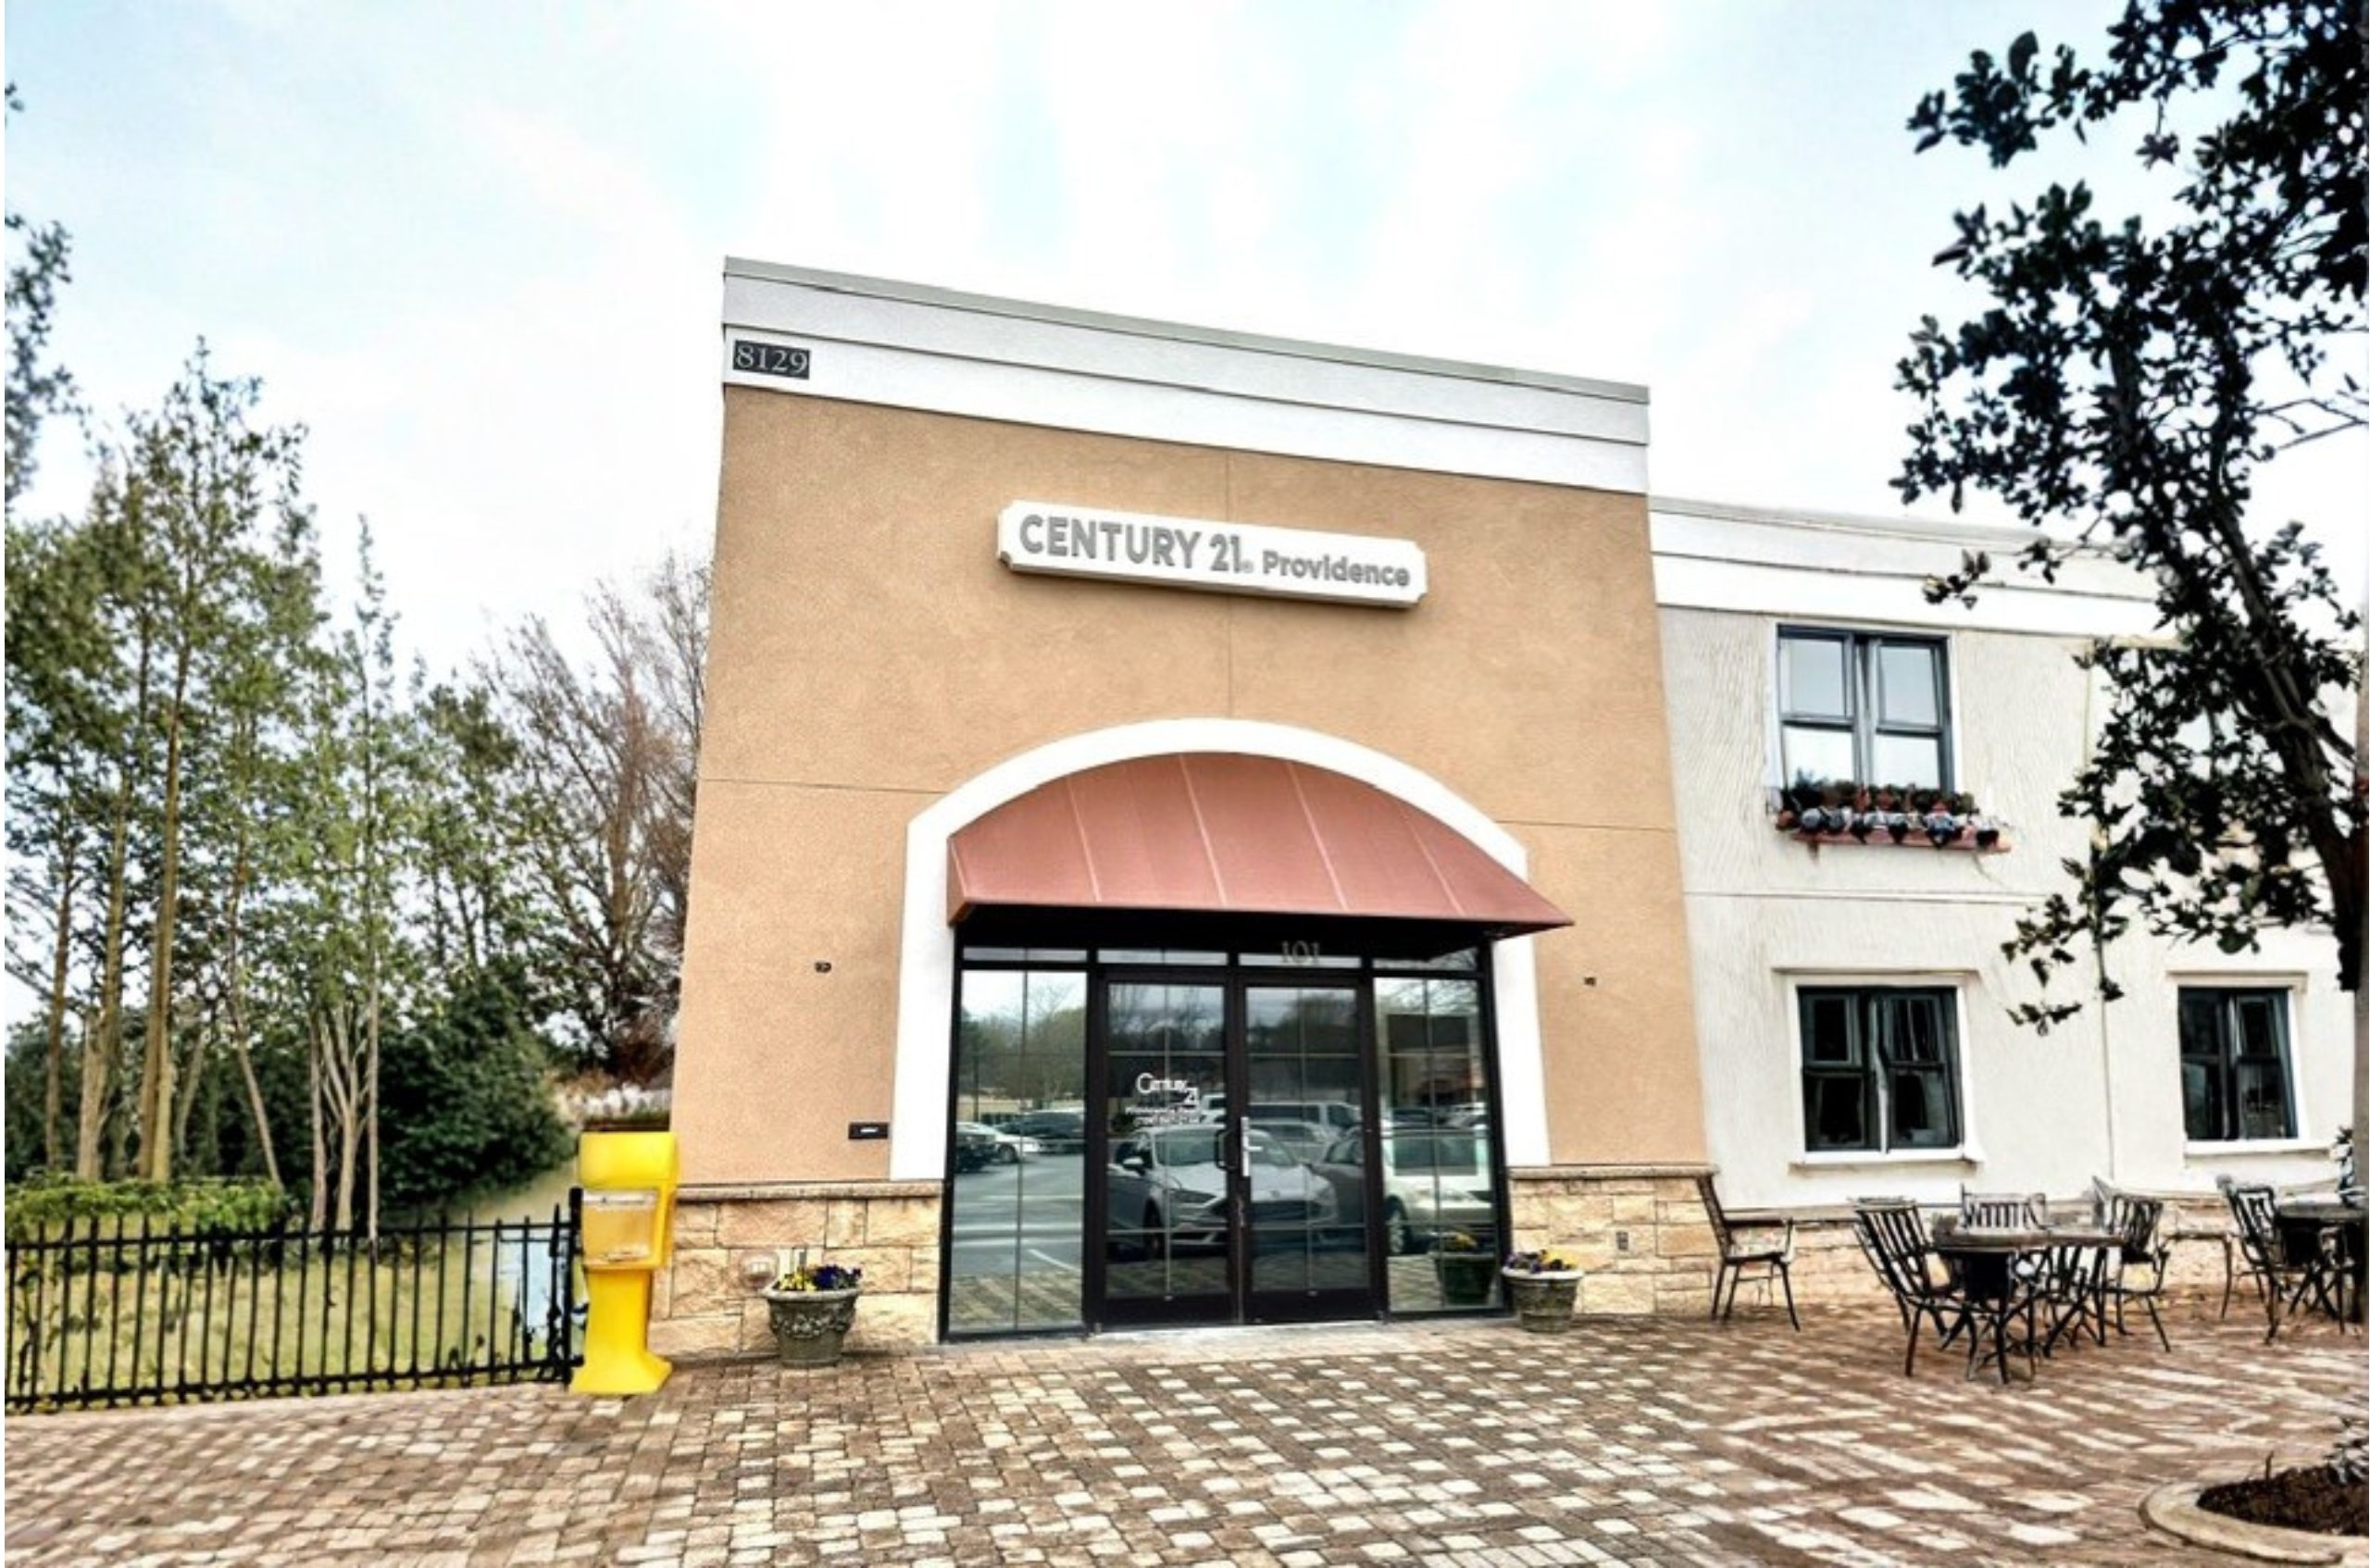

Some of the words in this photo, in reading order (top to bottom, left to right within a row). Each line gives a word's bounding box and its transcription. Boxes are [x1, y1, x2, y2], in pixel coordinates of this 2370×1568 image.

[736, 344, 808, 373] 8129
[1019, 514, 1202, 568] CENTURY
[1262, 550, 1411, 586] Providence
[1281, 940, 1320, 964] 101
